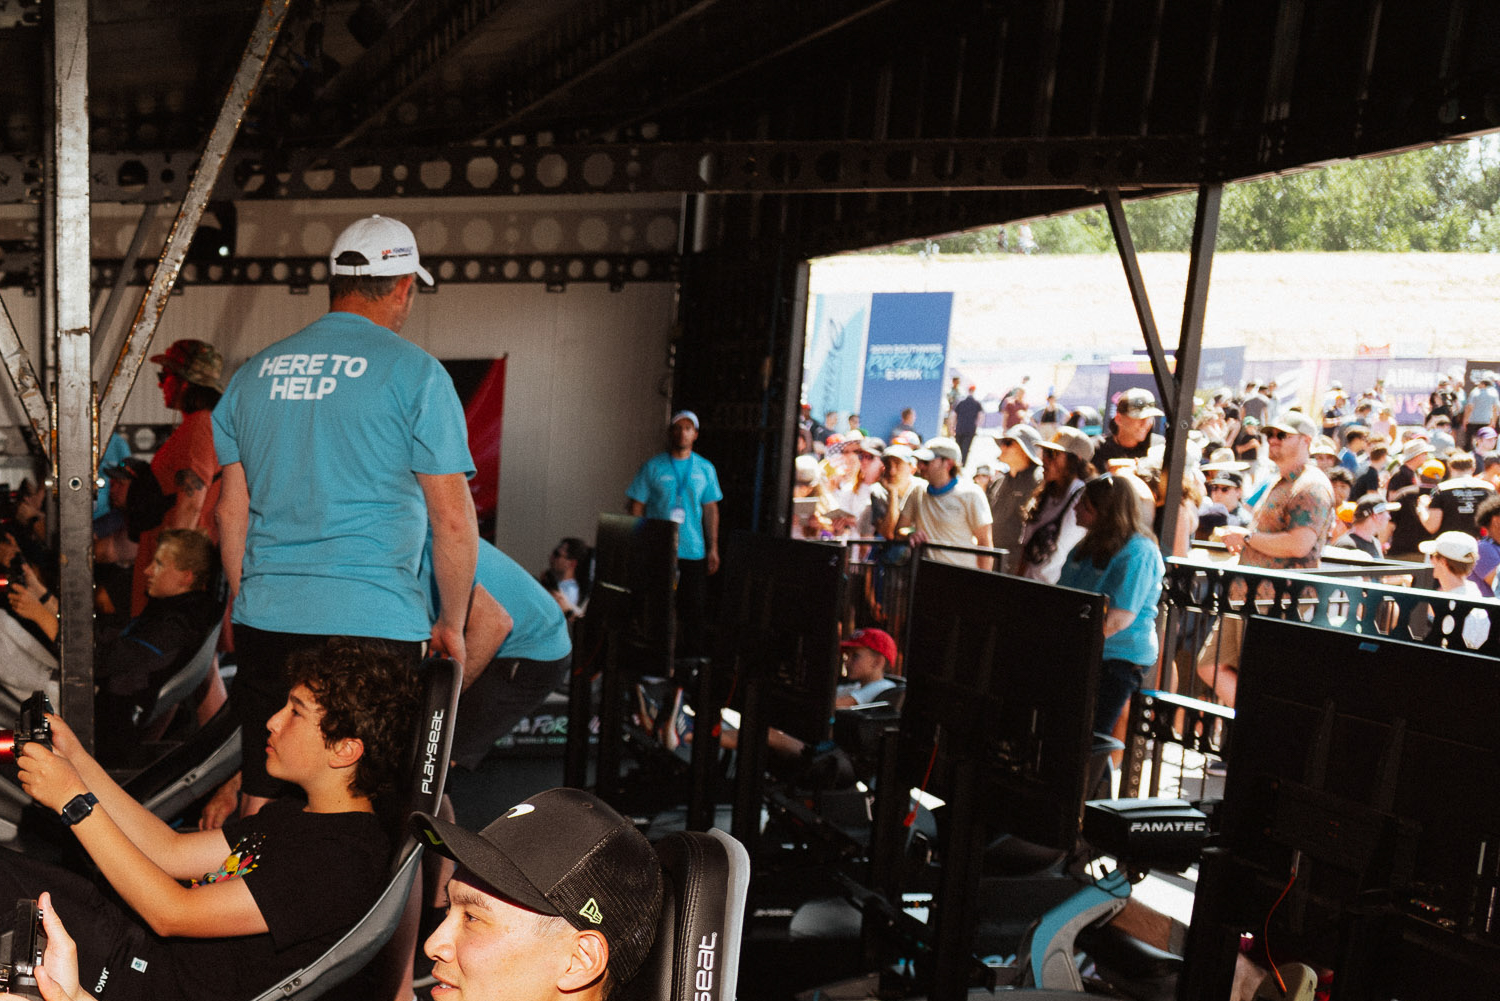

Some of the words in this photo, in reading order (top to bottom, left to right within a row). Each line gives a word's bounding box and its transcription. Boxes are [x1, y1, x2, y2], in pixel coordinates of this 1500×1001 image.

[258, 353, 329, 378] HERE
[330, 354, 368, 378] TO
[270, 377, 337, 400] HELP
[1130, 822, 1206, 833] FANATEC
[94, 967, 110, 993] JAKO
